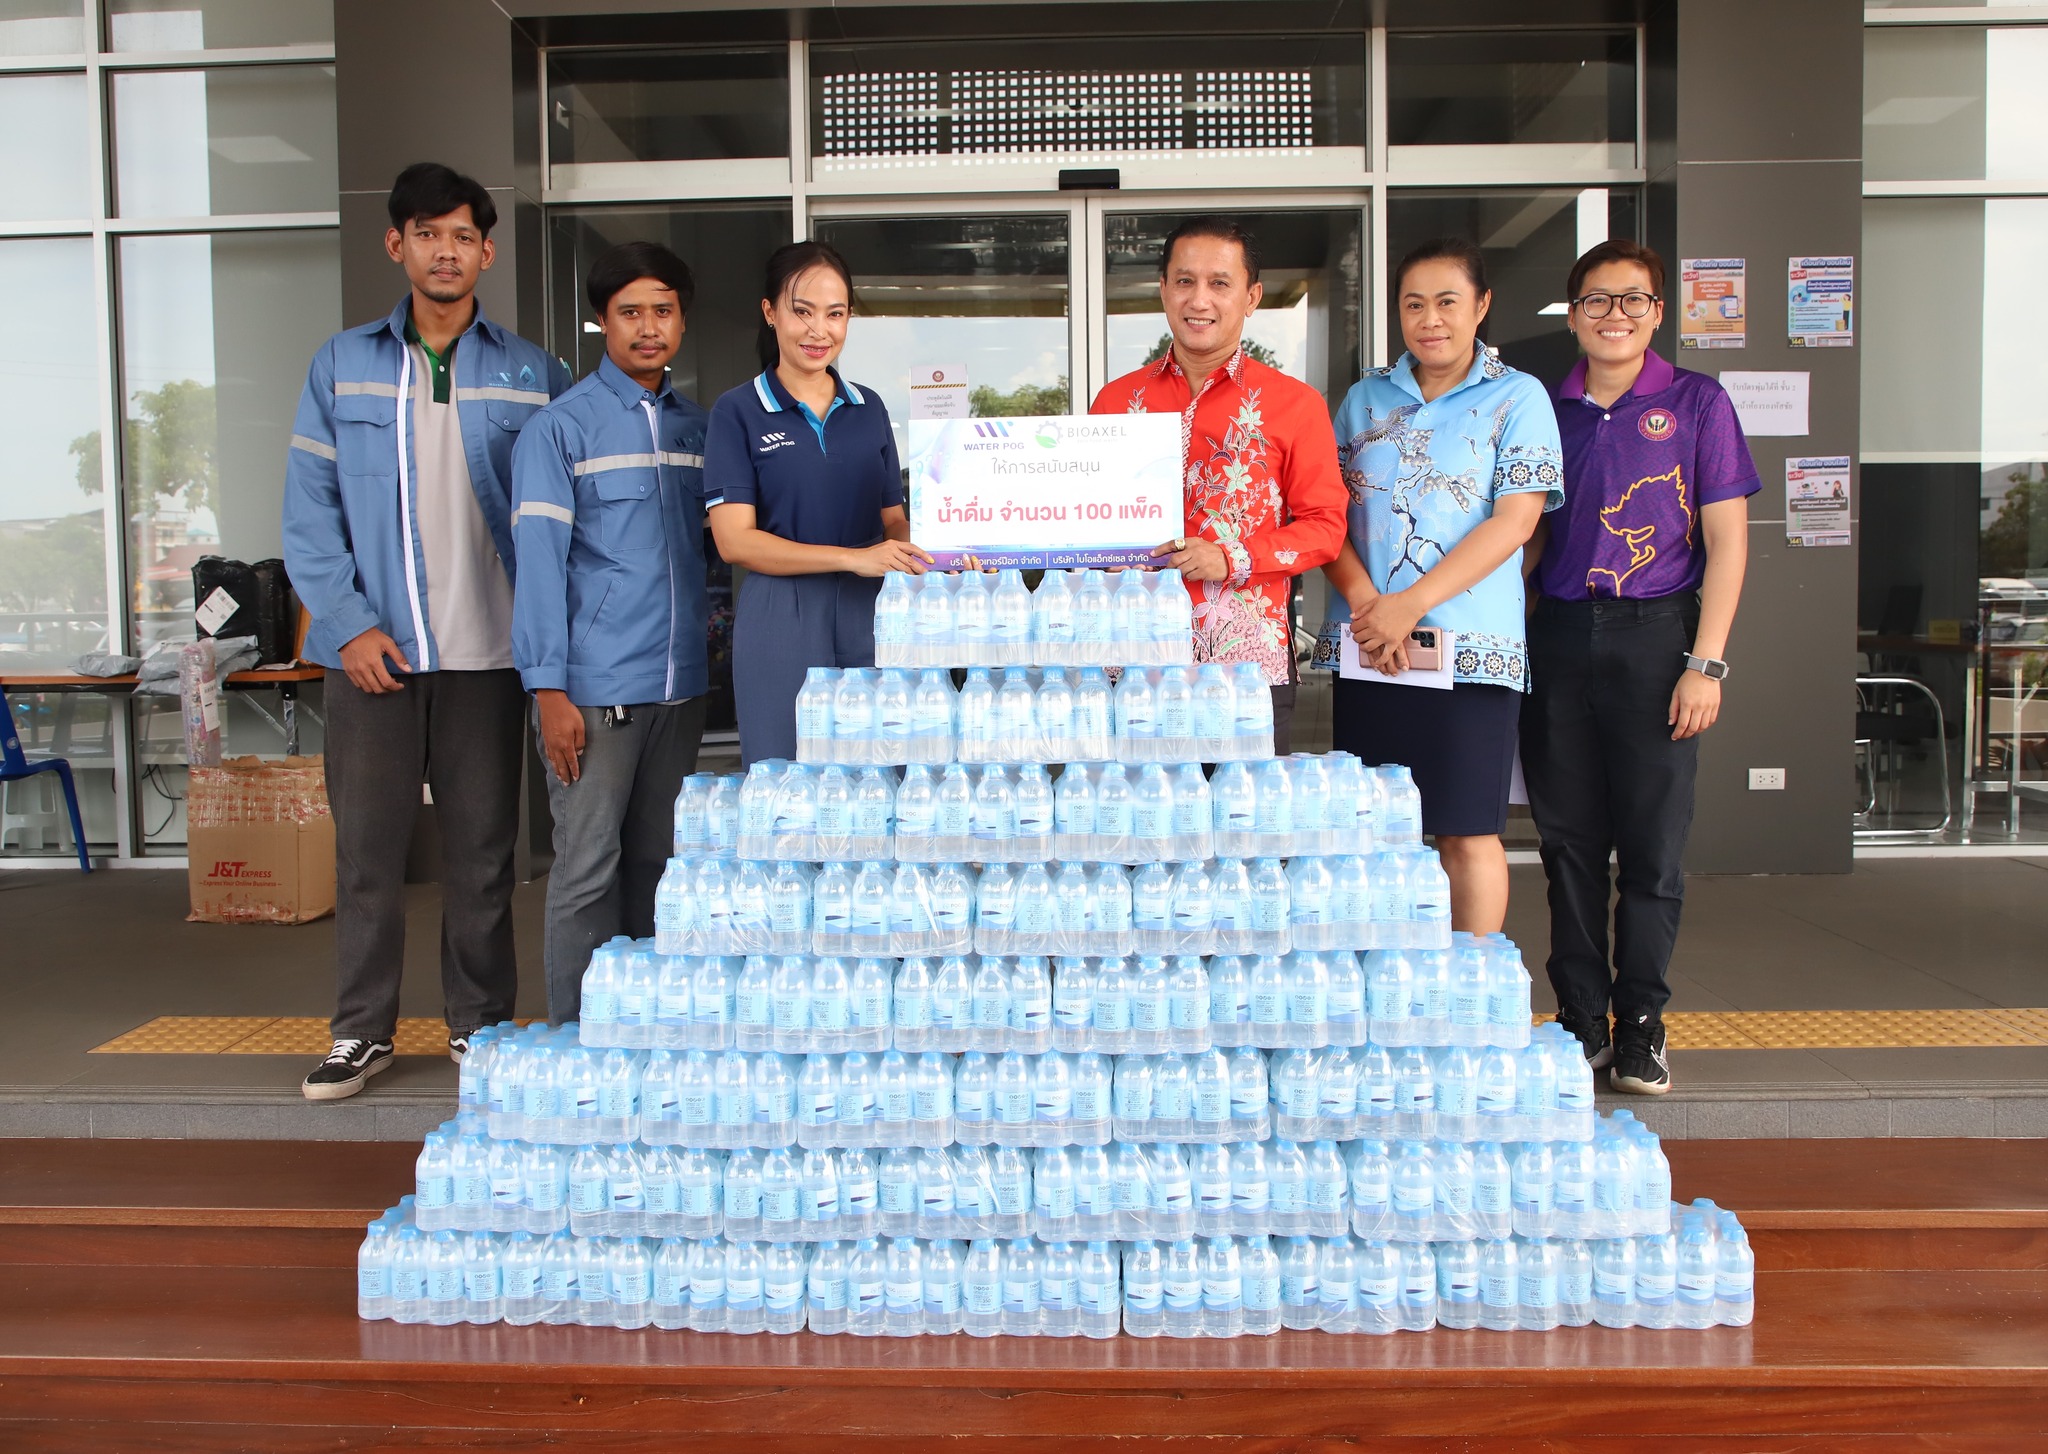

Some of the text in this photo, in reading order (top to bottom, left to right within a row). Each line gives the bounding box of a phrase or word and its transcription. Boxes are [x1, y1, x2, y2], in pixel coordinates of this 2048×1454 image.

[1067, 426, 1127, 438] BIOAXEL
[760, 442, 780, 452] WATER
[963, 442, 1025, 451] WATER POG
[992, 457, 1100, 476] ให้การสนับสนุน
[938, 496, 1162, 523] น้ำดื่ม จำนวน 100 แพ็ค
[1021, 555, 1042, 564] จำกัด
[1052, 555, 1075, 564] บริษัท
[1128, 553, 1149, 562] จำกัด
[208, 862, 248, 877] J&T
